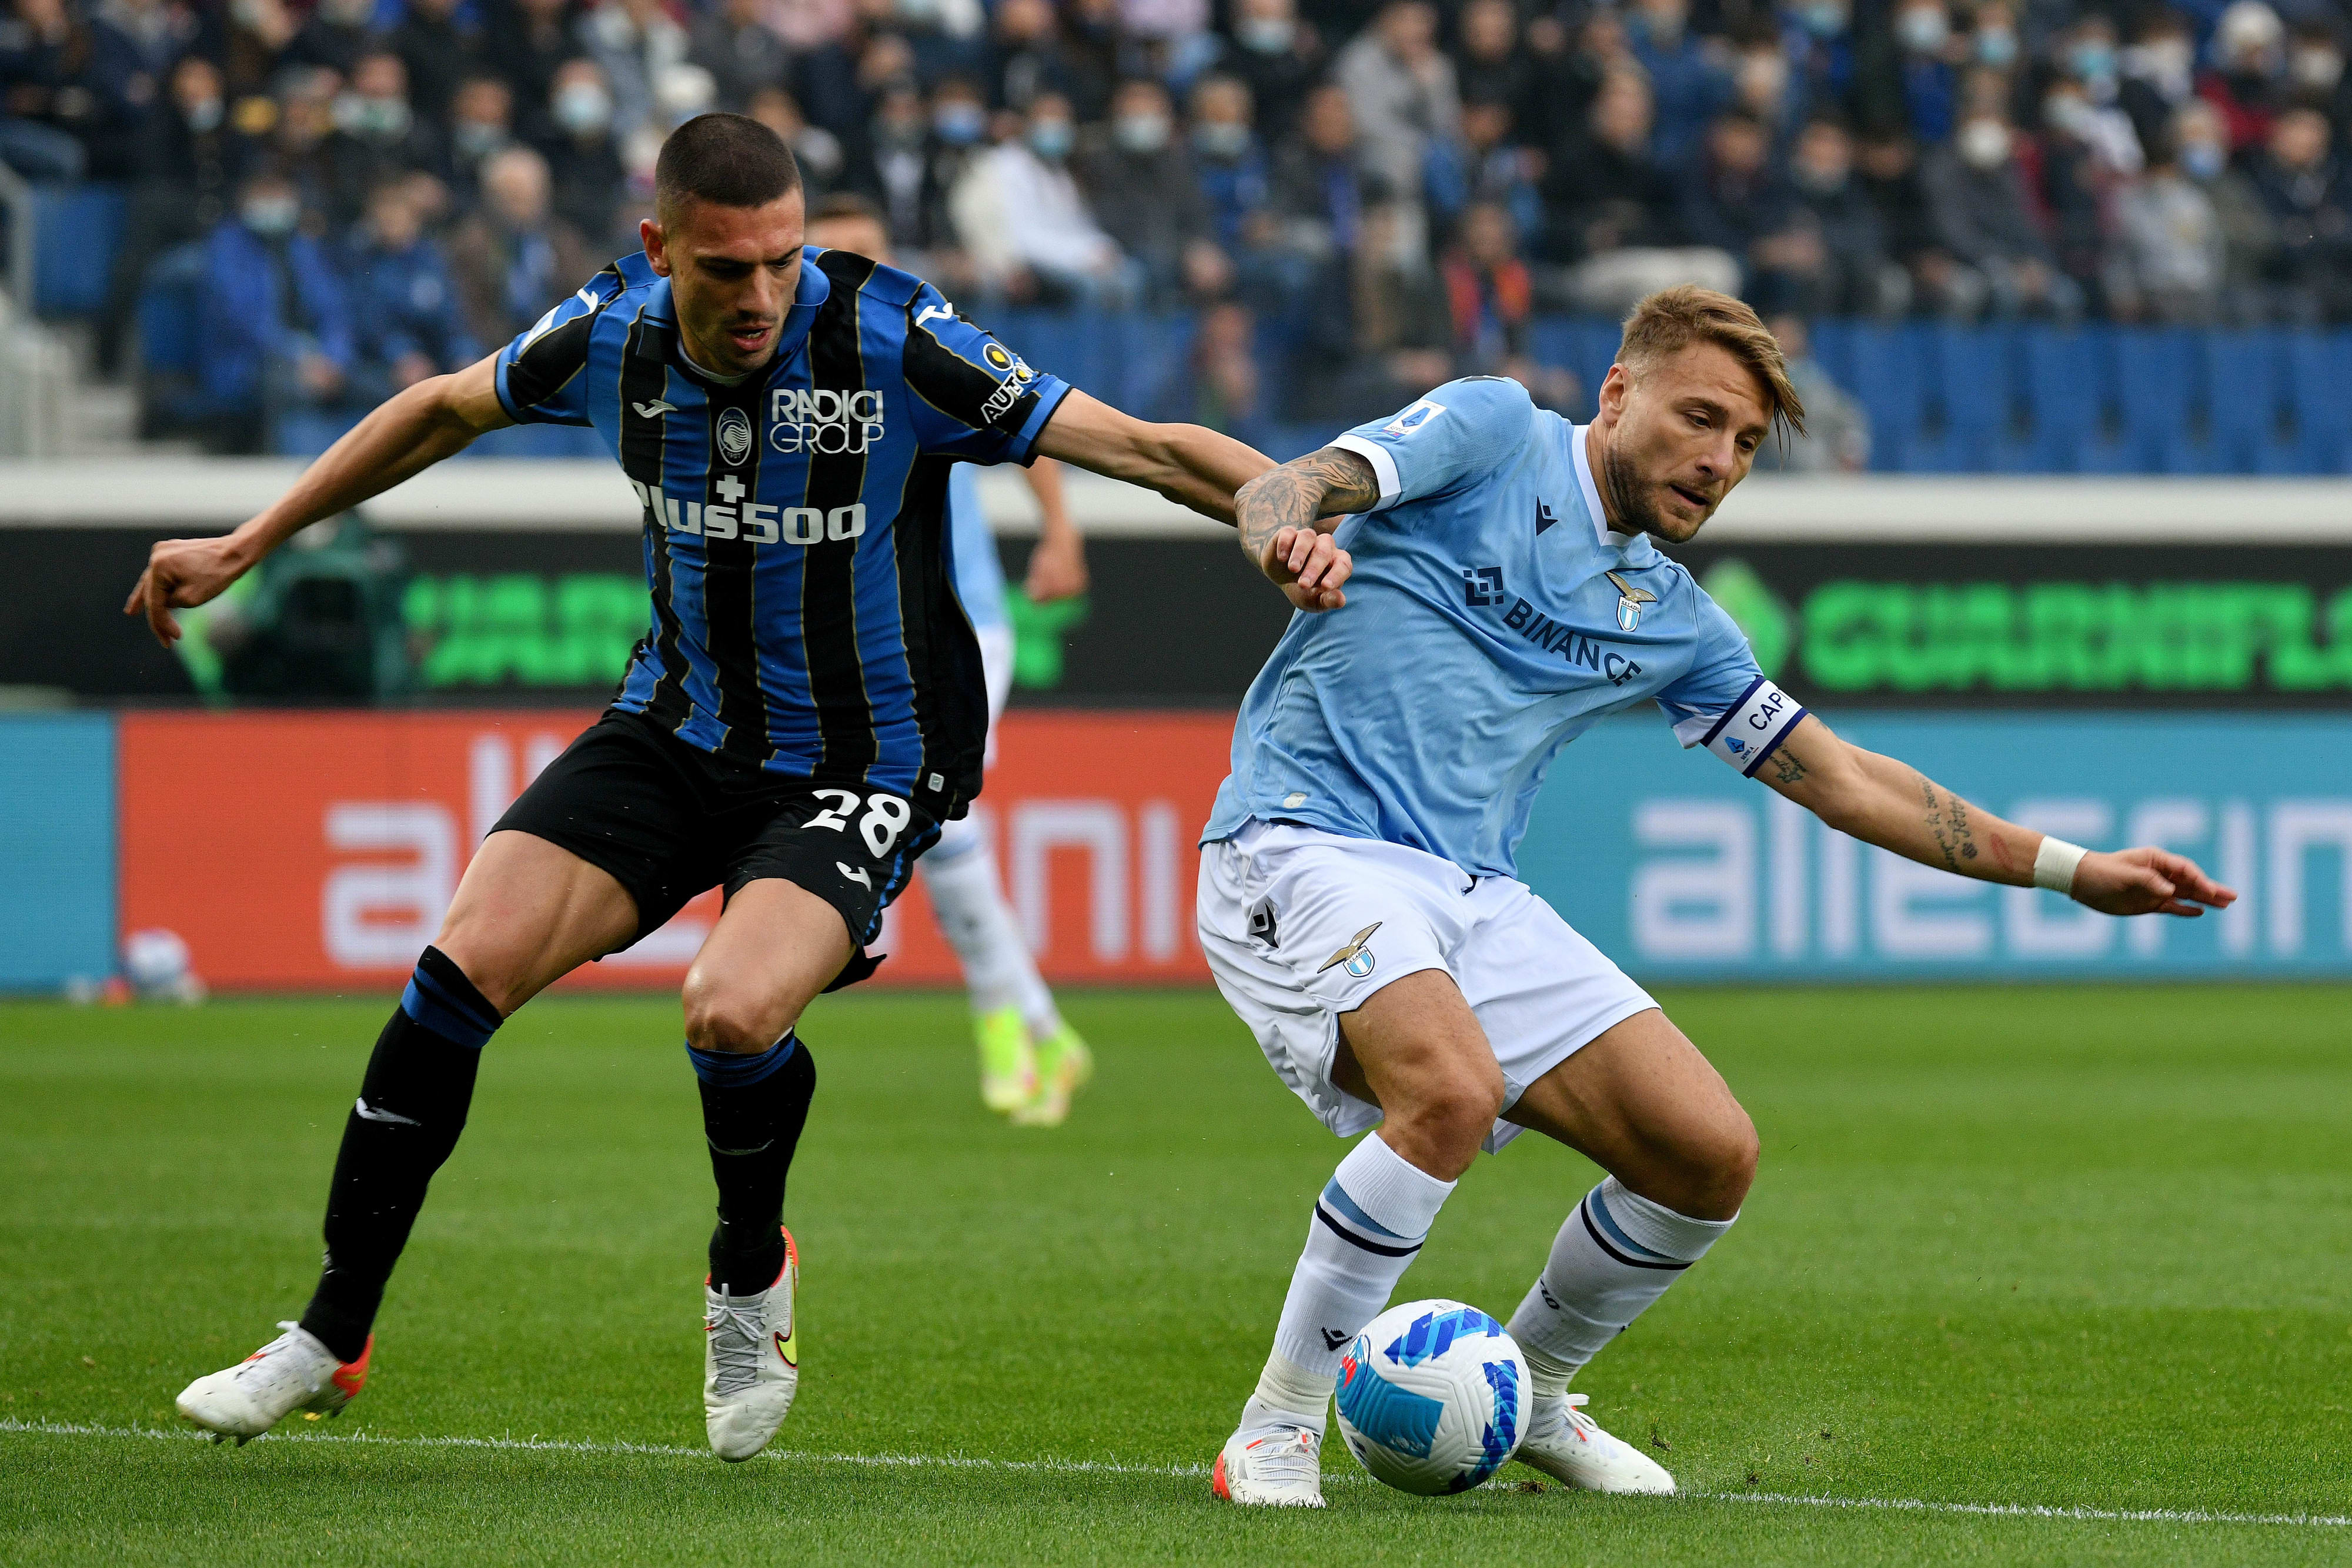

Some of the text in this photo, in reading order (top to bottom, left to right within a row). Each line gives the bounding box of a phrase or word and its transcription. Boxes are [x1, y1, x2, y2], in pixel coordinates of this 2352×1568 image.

[772, 389, 884, 423] RADICI
[769, 422, 885, 454] GROUP
[1502, 597, 1642, 687] BINANCE
[800, 788, 911, 858] 28
